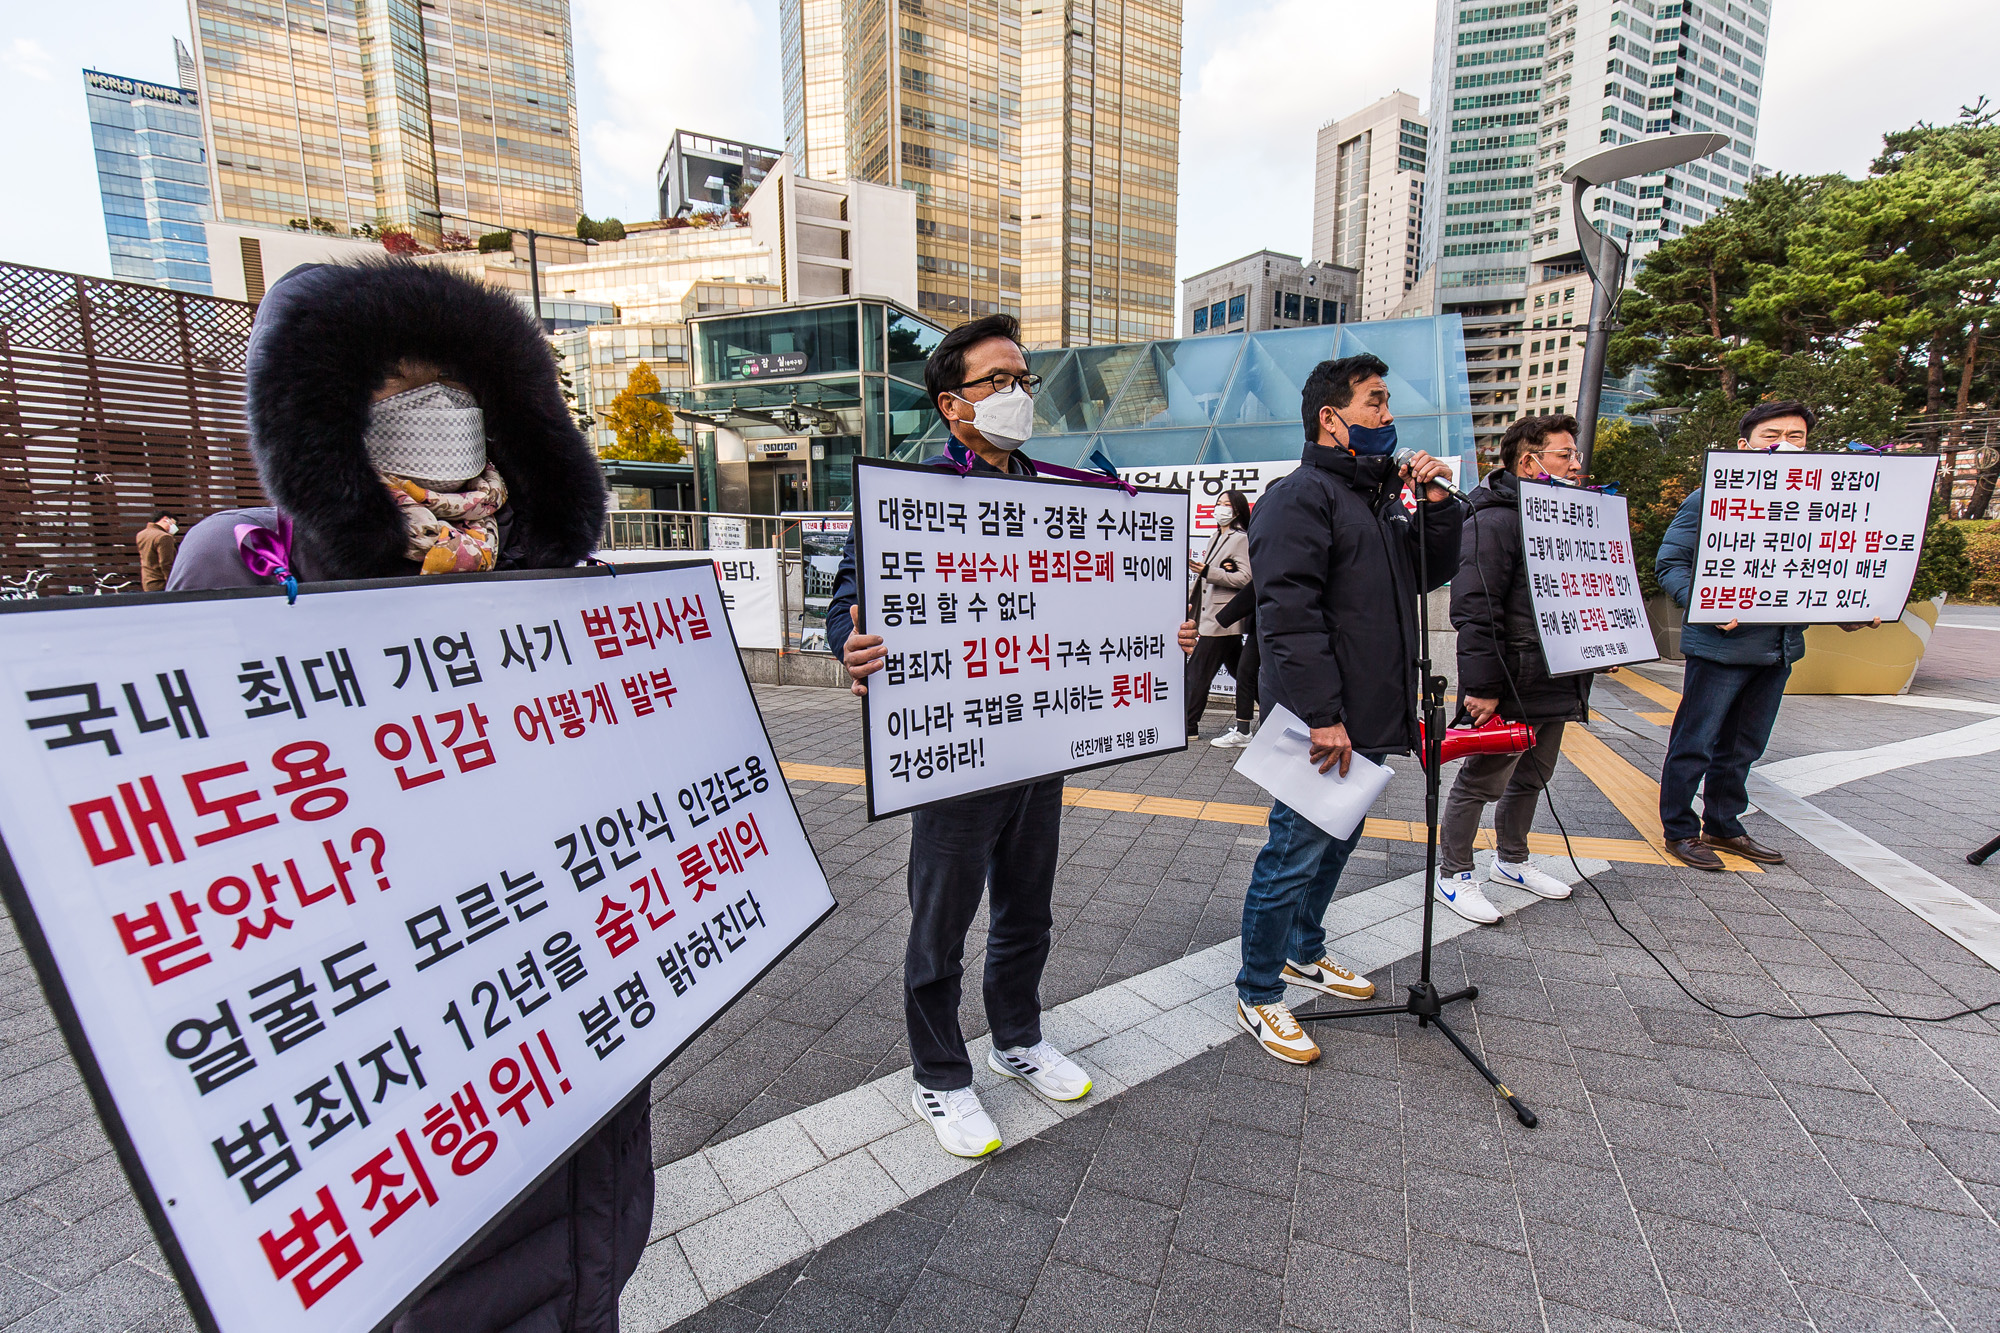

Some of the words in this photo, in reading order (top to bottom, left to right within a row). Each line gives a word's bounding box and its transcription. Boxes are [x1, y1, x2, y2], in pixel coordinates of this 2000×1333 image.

[85, 71, 133, 93] WORLD
[135, 82, 181, 103] TOWER
[1713, 468, 1778, 489] 일본기업
[1785, 468, 1822, 491] 롯데
[1830, 470, 1880, 491] 앞잡이
[878, 497, 967, 534] 대한민국
[1096, 508, 1175, 541] 수사관을
[1526, 497, 1558, 524] 대한민국
[1562, 502, 1584, 527] 노른자
[1586, 505, 1594, 528] 땅
[1710, 498, 1800, 521] 매국노들은
[1807, 501, 1857, 522] 들어라
[1528, 536, 1554, 561] 그렇게
[1556, 537, 1573, 562] 많이
[1574, 538, 1597, 563] 가지고
[1599, 541, 1608, 561] 또
[1608, 539, 1625, 564] 강탈
[1706, 531, 1755, 552] 이나라
[1763, 532, 1812, 552] 국민이
[1819, 530, 1857, 553] 피와
[1864, 530, 1915, 552] 땀으로
[880, 551, 925, 583] 모두
[935, 551, 1019, 583] 부실수사
[1028, 550, 1114, 583] 범죄은폐
[1123, 556, 1172, 581] 막이에
[1702, 558, 1736, 578] 모은
[1743, 558, 1776, 578] 재산
[1782, 558, 1848, 578] 수천억이
[1855, 558, 1887, 578] 매년
[1533, 573, 1560, 598] 롯데는
[1561, 571, 1581, 597] 위조
[1581, 572, 1616, 597] 전문기업
[1616, 574, 1632, 597] 인가
[1700, 586, 1788, 609] 일본땅으로
[1796, 588, 1827, 608] 가고
[1836, 589, 1870, 608] 있다.
[881, 592, 926, 627] 동원
[937, 592, 958, 624] 할
[968, 592, 988, 622] 수
[997, 592, 1036, 621] 없다
[1540, 611, 1561, 636] 뒤에
[1561, 610, 1580, 635] 숨어
[1579, 607, 1609, 632] 도적질
[25, 669, 209, 756] 국내
[237, 648, 366, 719] 최대
[384, 632, 483, 693] 기업
[500, 620, 573, 672] 사기
[581, 594, 712, 659] 범죄사실
[885, 649, 952, 685] 범죄자
[963, 634, 1050, 678] 김안식
[1056, 639, 1092, 668] 구속
[1099, 634, 1165, 663] 수사하라
[888, 702, 954, 740] 이나라
[963, 693, 1023, 728] 국법을
[1033, 684, 1104, 718] 무시하는
[1111, 671, 1168, 709] 롯데는
[1070, 735, 1113, 759] (선진개발
[1116, 731, 1134, 749] 직원
[1138, 727, 1159, 746] 일동)
[69, 741, 349, 866] 매도용
[374, 703, 496, 791] 인감
[513, 682, 619, 745] 어떻게
[621, 667, 678, 718] 발부
[889, 737, 985, 783] 각성하라!
[112, 827, 391, 986] 받았나?
[165, 940, 391, 1096] 얼굴도
[404, 870, 549, 972] 모르는
[554, 792, 676, 892] 김안식
[677, 755, 770, 828] 인감도용
[211, 1026, 428, 1204] 범죄자
[443, 930, 589, 1051] 12년을
[594, 867, 676, 959] 숨긴
[677, 813, 769, 903] 롯데의
[258, 1029, 573, 1310] 범죄행위!
[578, 971, 650, 1061] 분명
[656, 889, 767, 998] 밝혀진다
